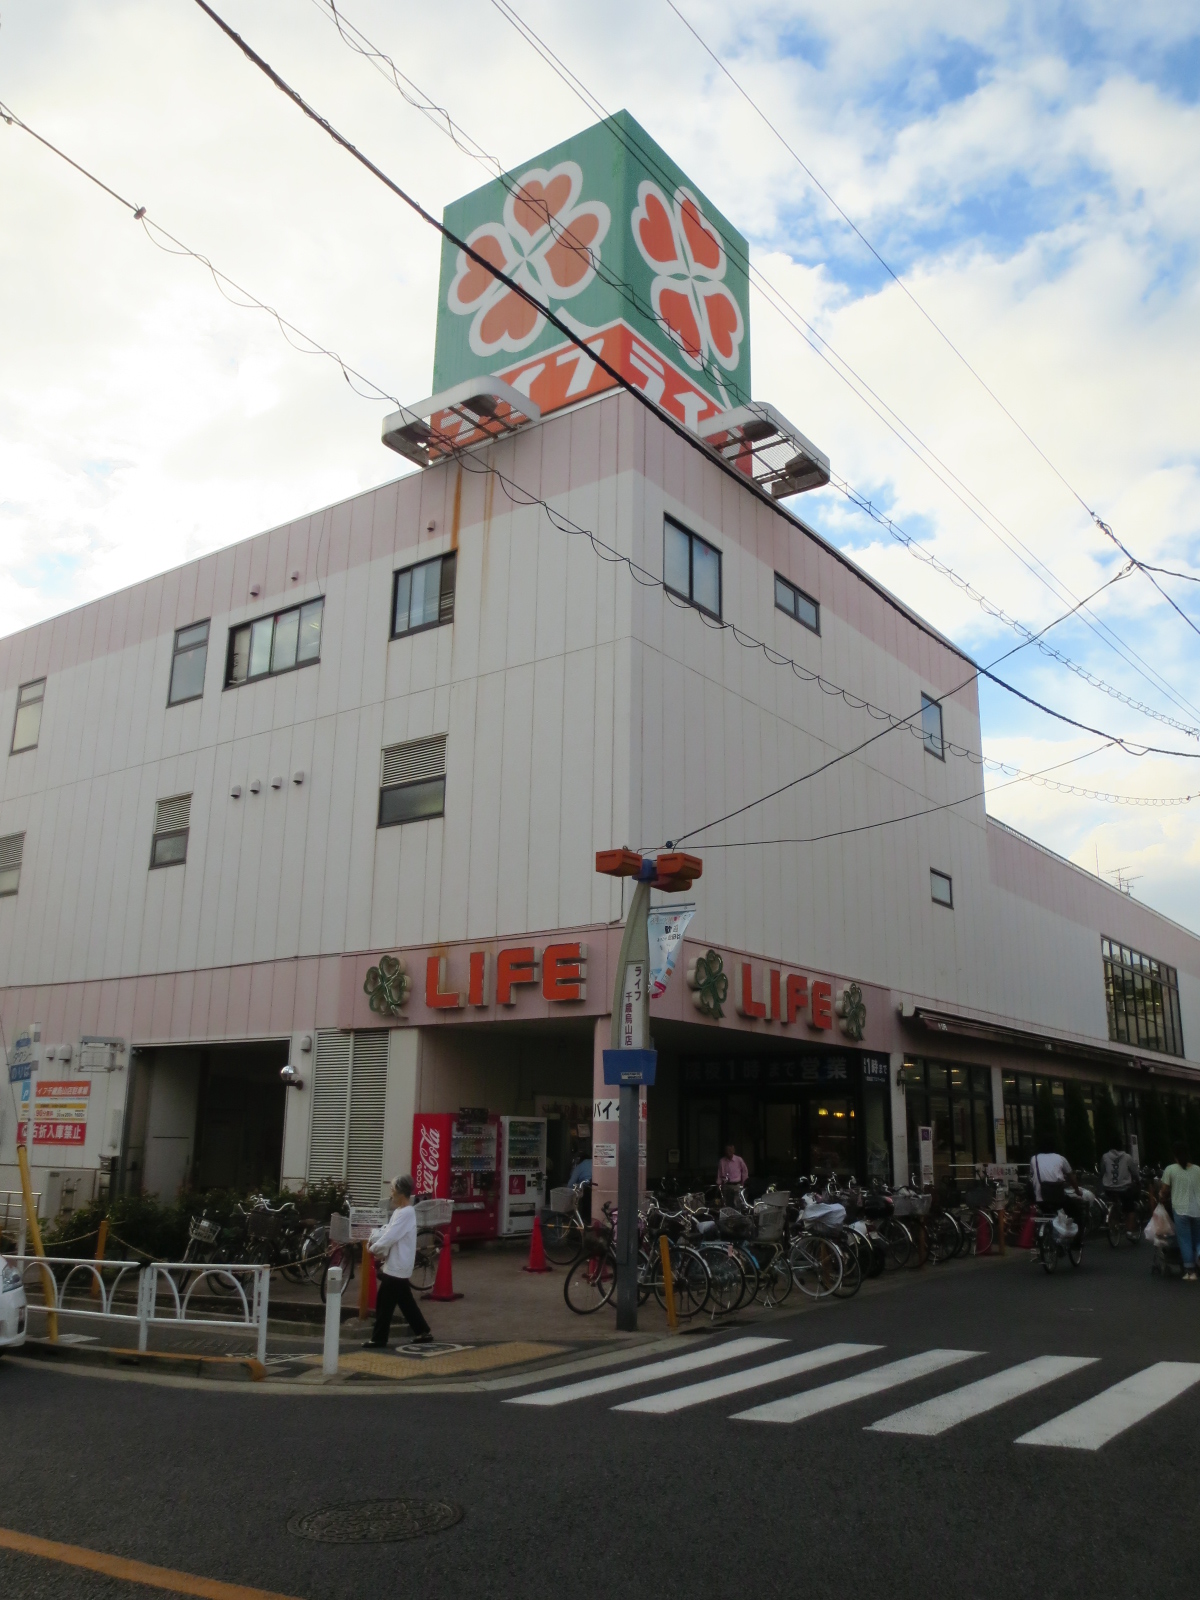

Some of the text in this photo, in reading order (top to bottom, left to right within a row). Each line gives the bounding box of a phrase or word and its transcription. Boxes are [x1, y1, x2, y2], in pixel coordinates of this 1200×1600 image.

[426, 942, 587, 1009] LIFE
[634, 966, 642, 1001] ライフ
[738, 962, 832, 1031] LIFE
[11, 1066, 31, 1079] のりば
[594, 1101, 620, 1120] バイ
